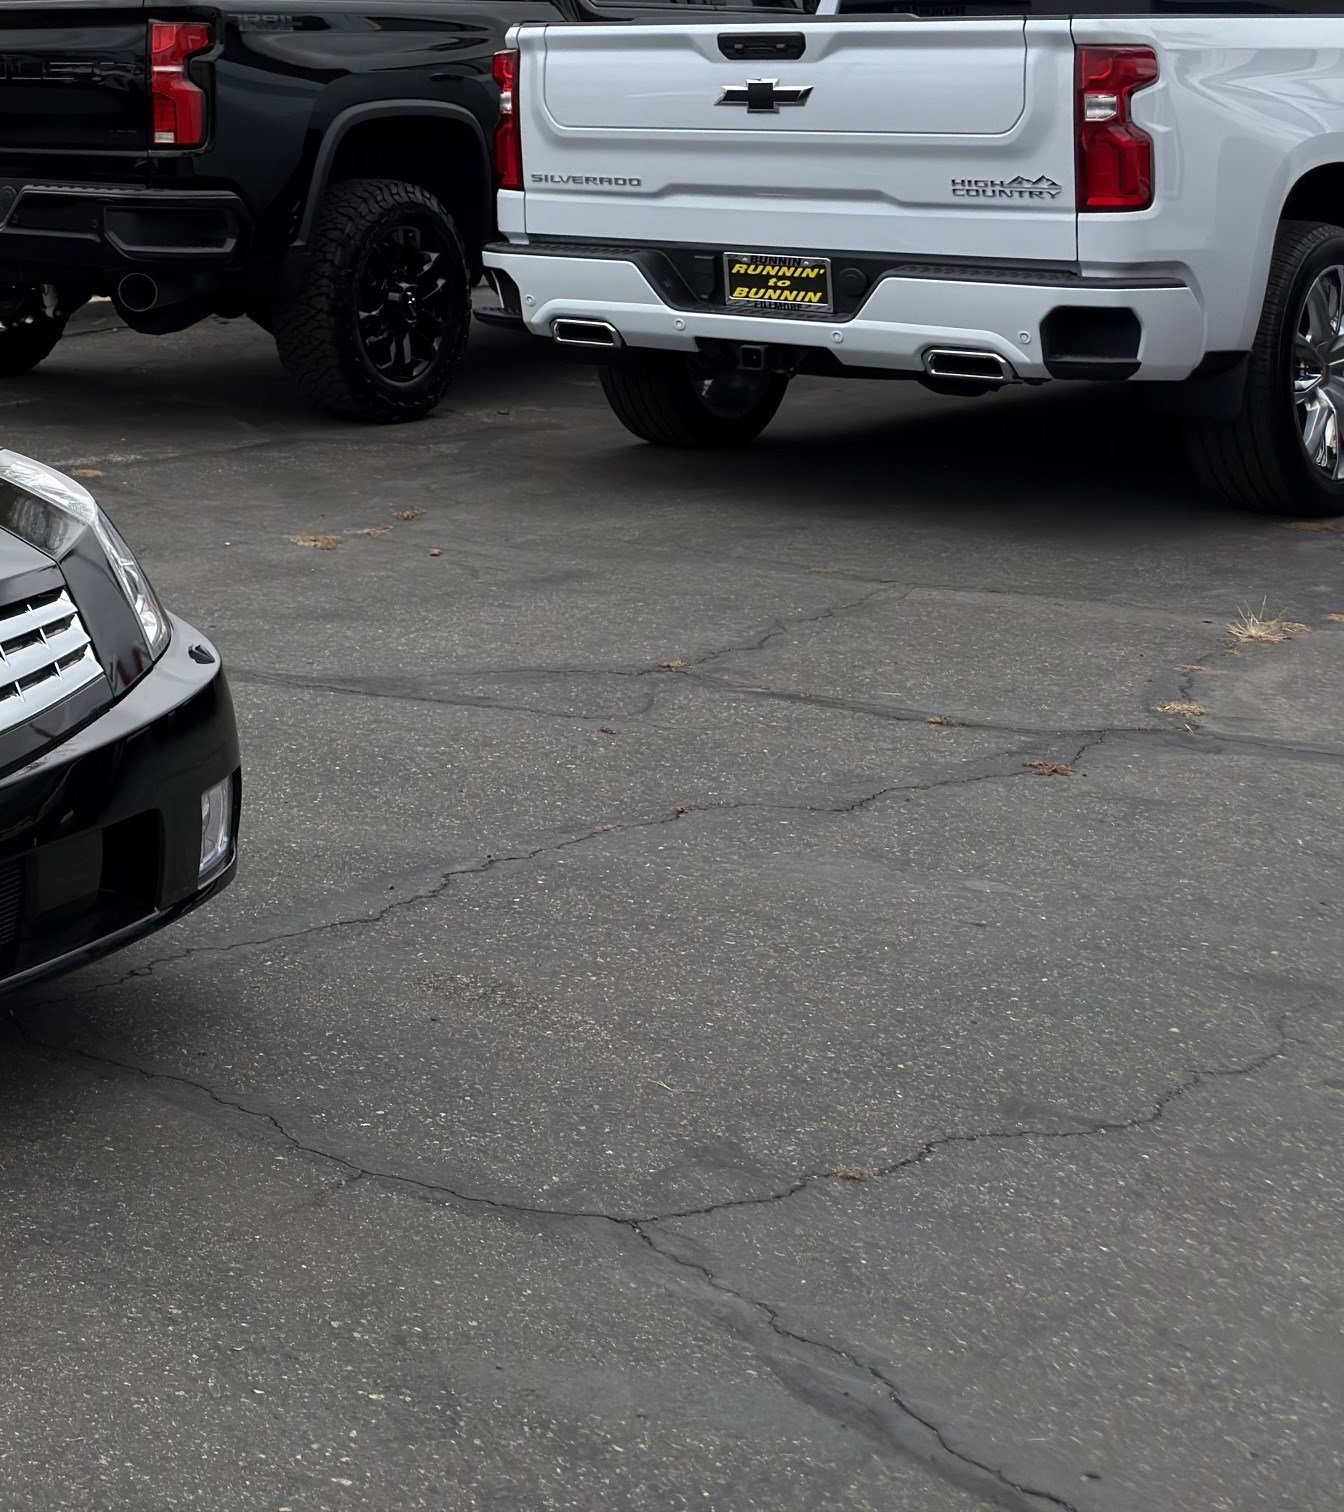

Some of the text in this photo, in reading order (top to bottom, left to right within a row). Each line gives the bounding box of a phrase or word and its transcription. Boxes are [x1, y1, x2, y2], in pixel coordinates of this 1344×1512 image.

[530, 173, 643, 187] SILVERADO
[951, 178, 1005, 188] HIGH
[952, 188, 1063, 200] COUNTRY
[731, 263, 826, 279] RUNNIN'
[767, 278, 791, 287] to
[732, 286, 823, 303] BUNNIN
